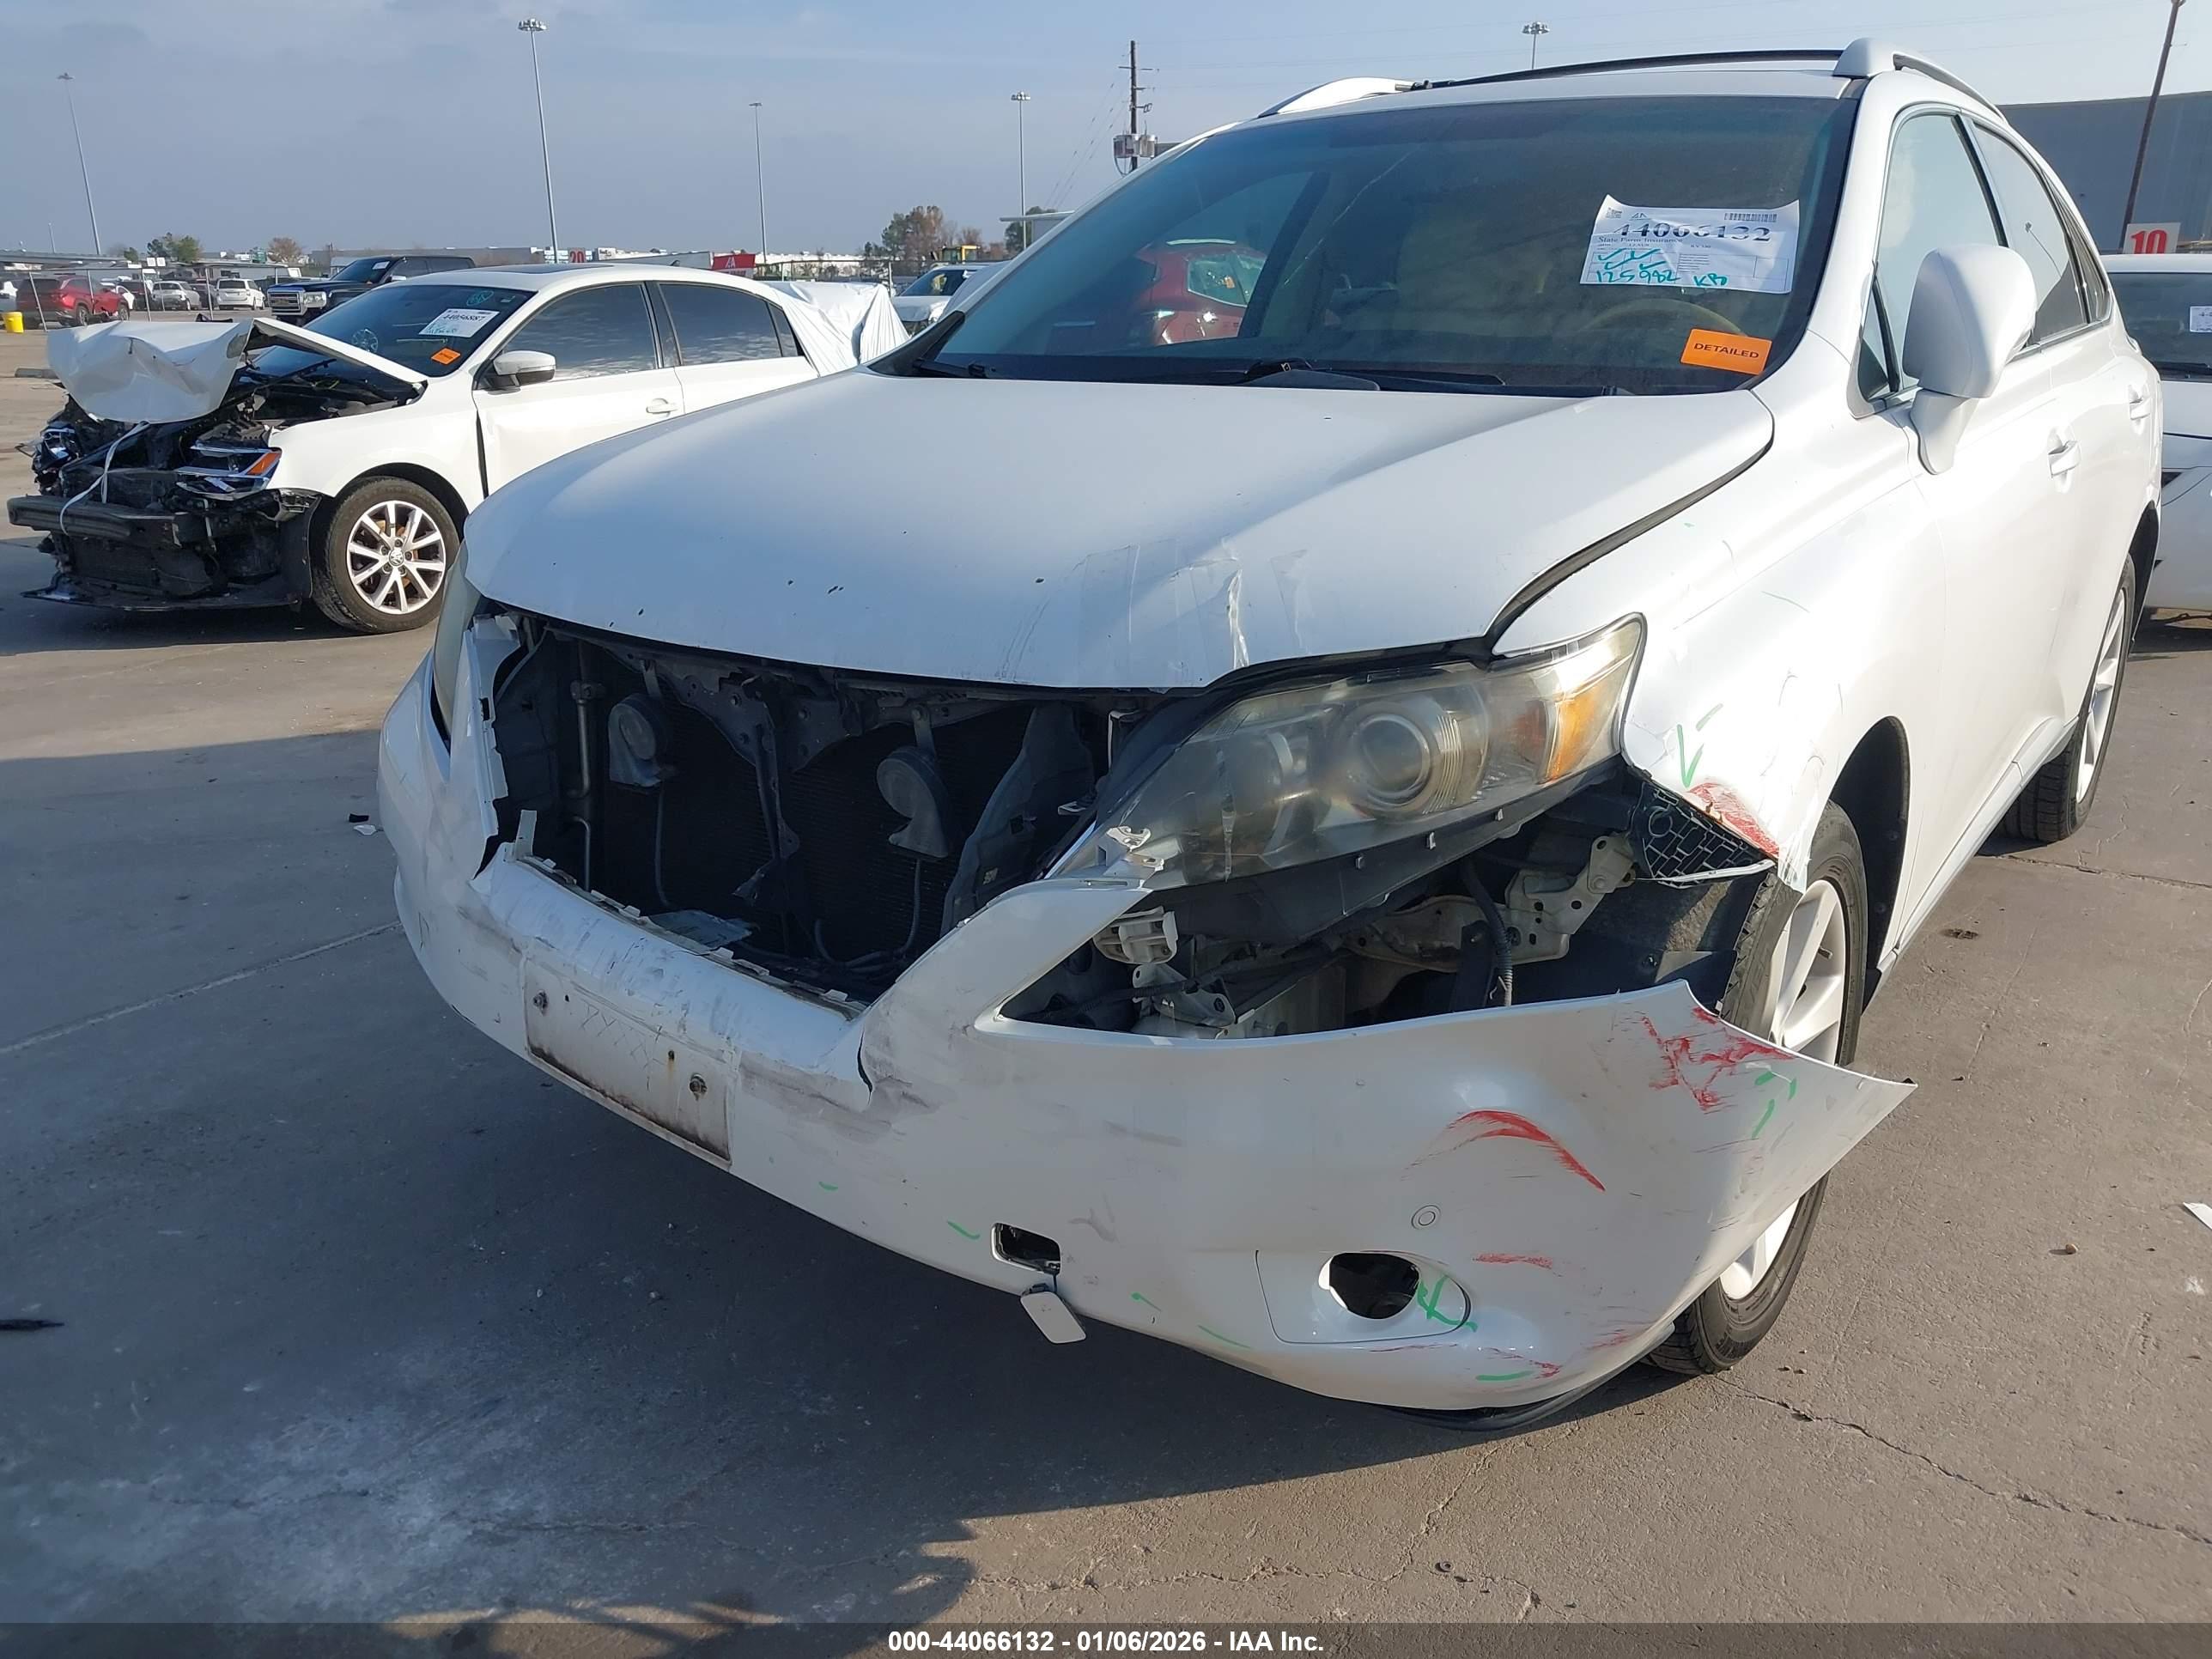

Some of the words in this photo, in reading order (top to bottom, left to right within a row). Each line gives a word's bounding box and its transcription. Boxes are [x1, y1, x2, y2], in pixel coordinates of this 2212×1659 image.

[1614, 222, 1771, 241] 44066132
[2130, 229, 2167, 253] 10
[1693, 343, 1759, 358] DETAILED
